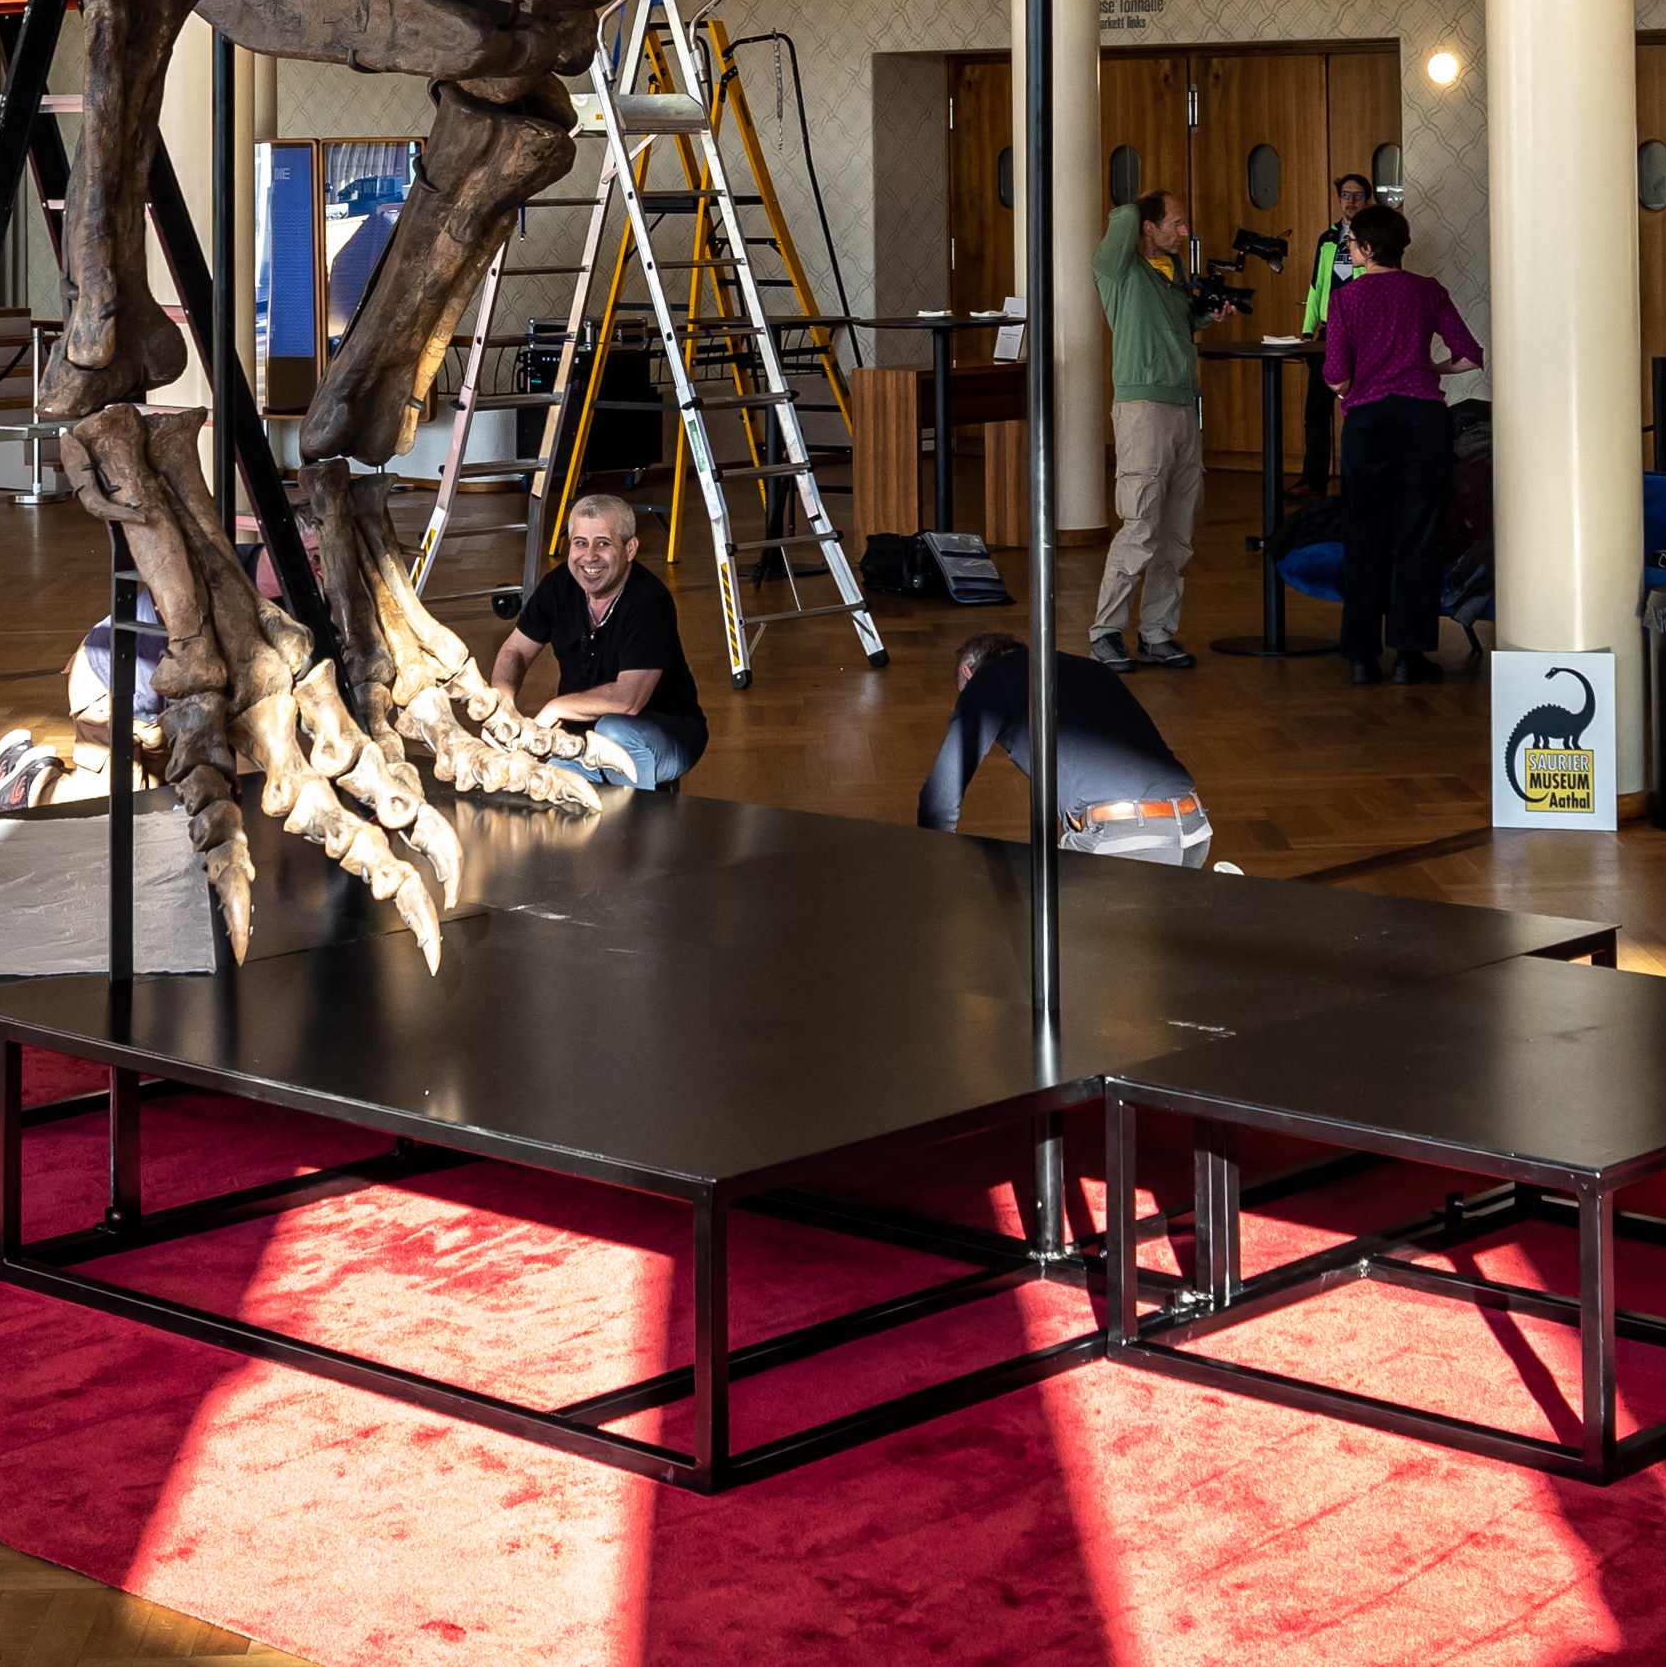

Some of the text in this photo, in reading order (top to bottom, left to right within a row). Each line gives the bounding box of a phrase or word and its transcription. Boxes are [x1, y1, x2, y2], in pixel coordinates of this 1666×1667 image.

[1529, 754, 1589, 772] SAURIER
[1530, 773, 1590, 790] MUSEUM
[1549, 791, 1590, 809] Aathal
